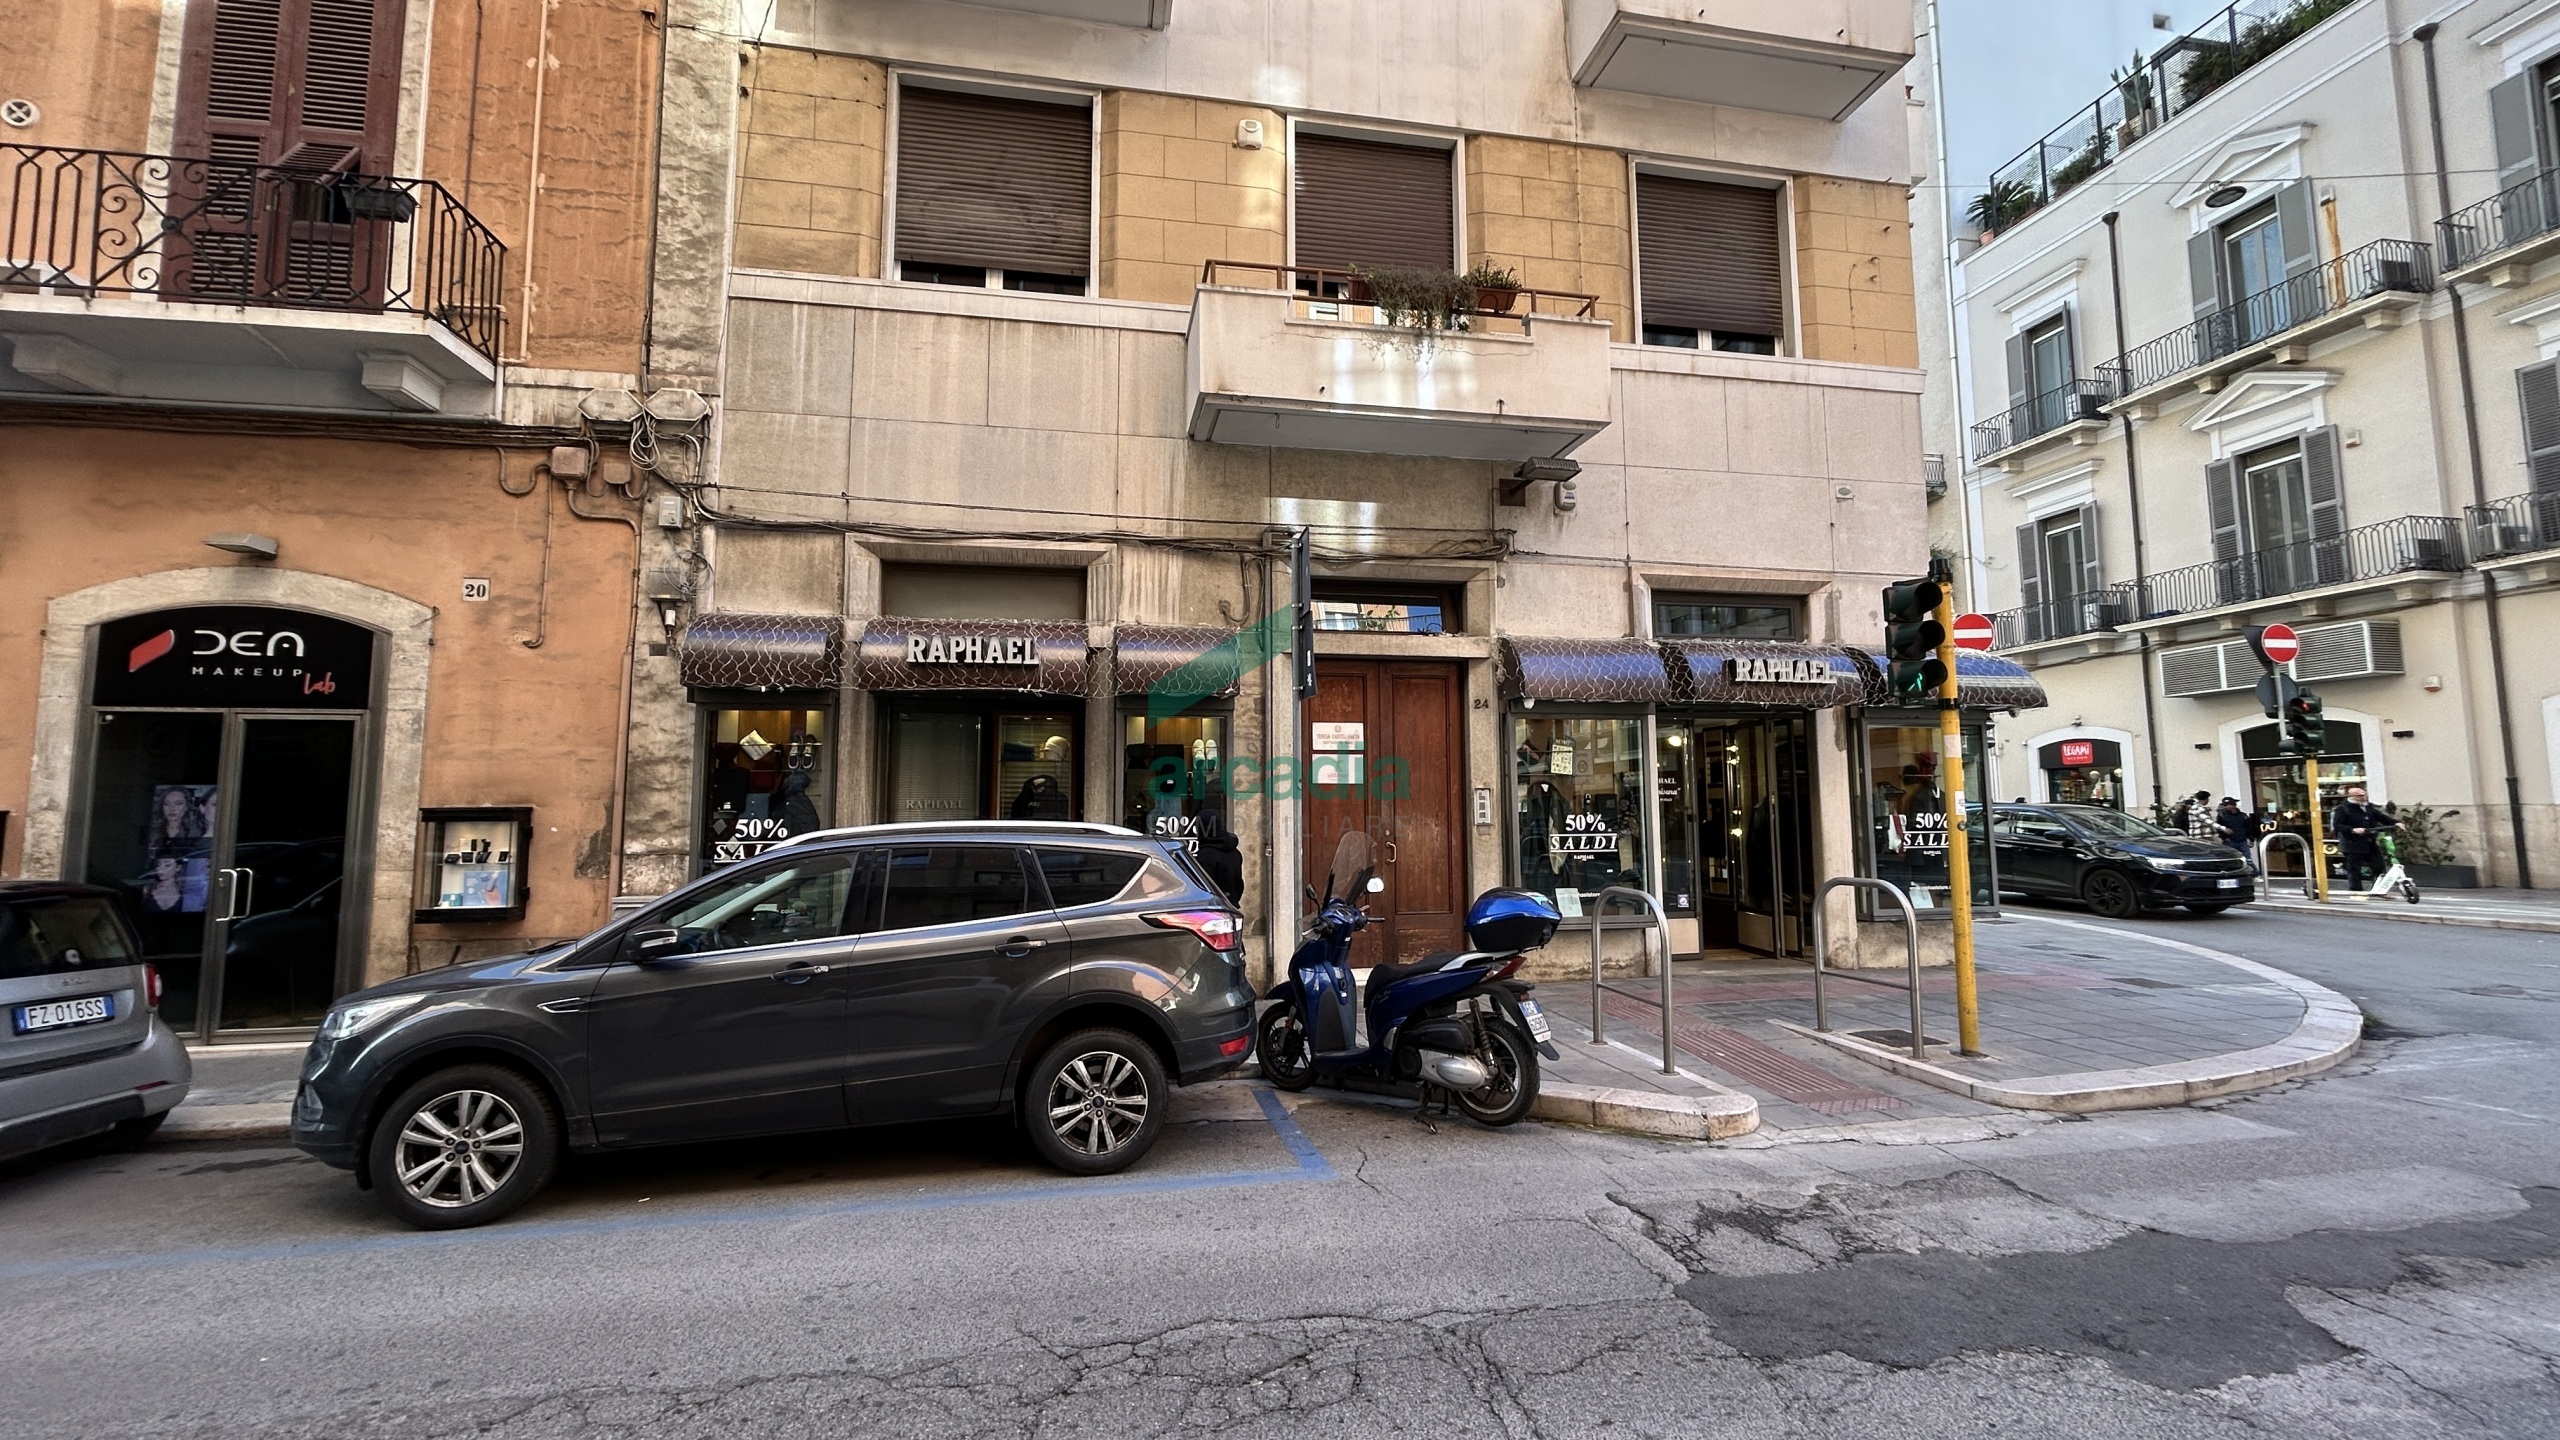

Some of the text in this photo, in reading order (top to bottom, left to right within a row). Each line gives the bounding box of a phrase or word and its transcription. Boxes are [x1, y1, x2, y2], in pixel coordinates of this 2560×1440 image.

[465, 583, 487, 598] 20
[906, 634, 1040, 665] RAPHAEL
[191, 667, 303, 677] MAKEUP
[1735, 656, 1838, 684] RAPHAEL
[1473, 698, 1490, 710] 24
[1658, 777, 1677, 785] HAEL
[906, 799, 965, 810] RAPHAEL
[735, 818, 788, 839] 50%
[1155, 815, 1198, 836] 50%
[1565, 813, 1606, 832] 50%
[1915, 812, 1948, 829] 50%
[1550, 835, 1618, 851] SALDI
